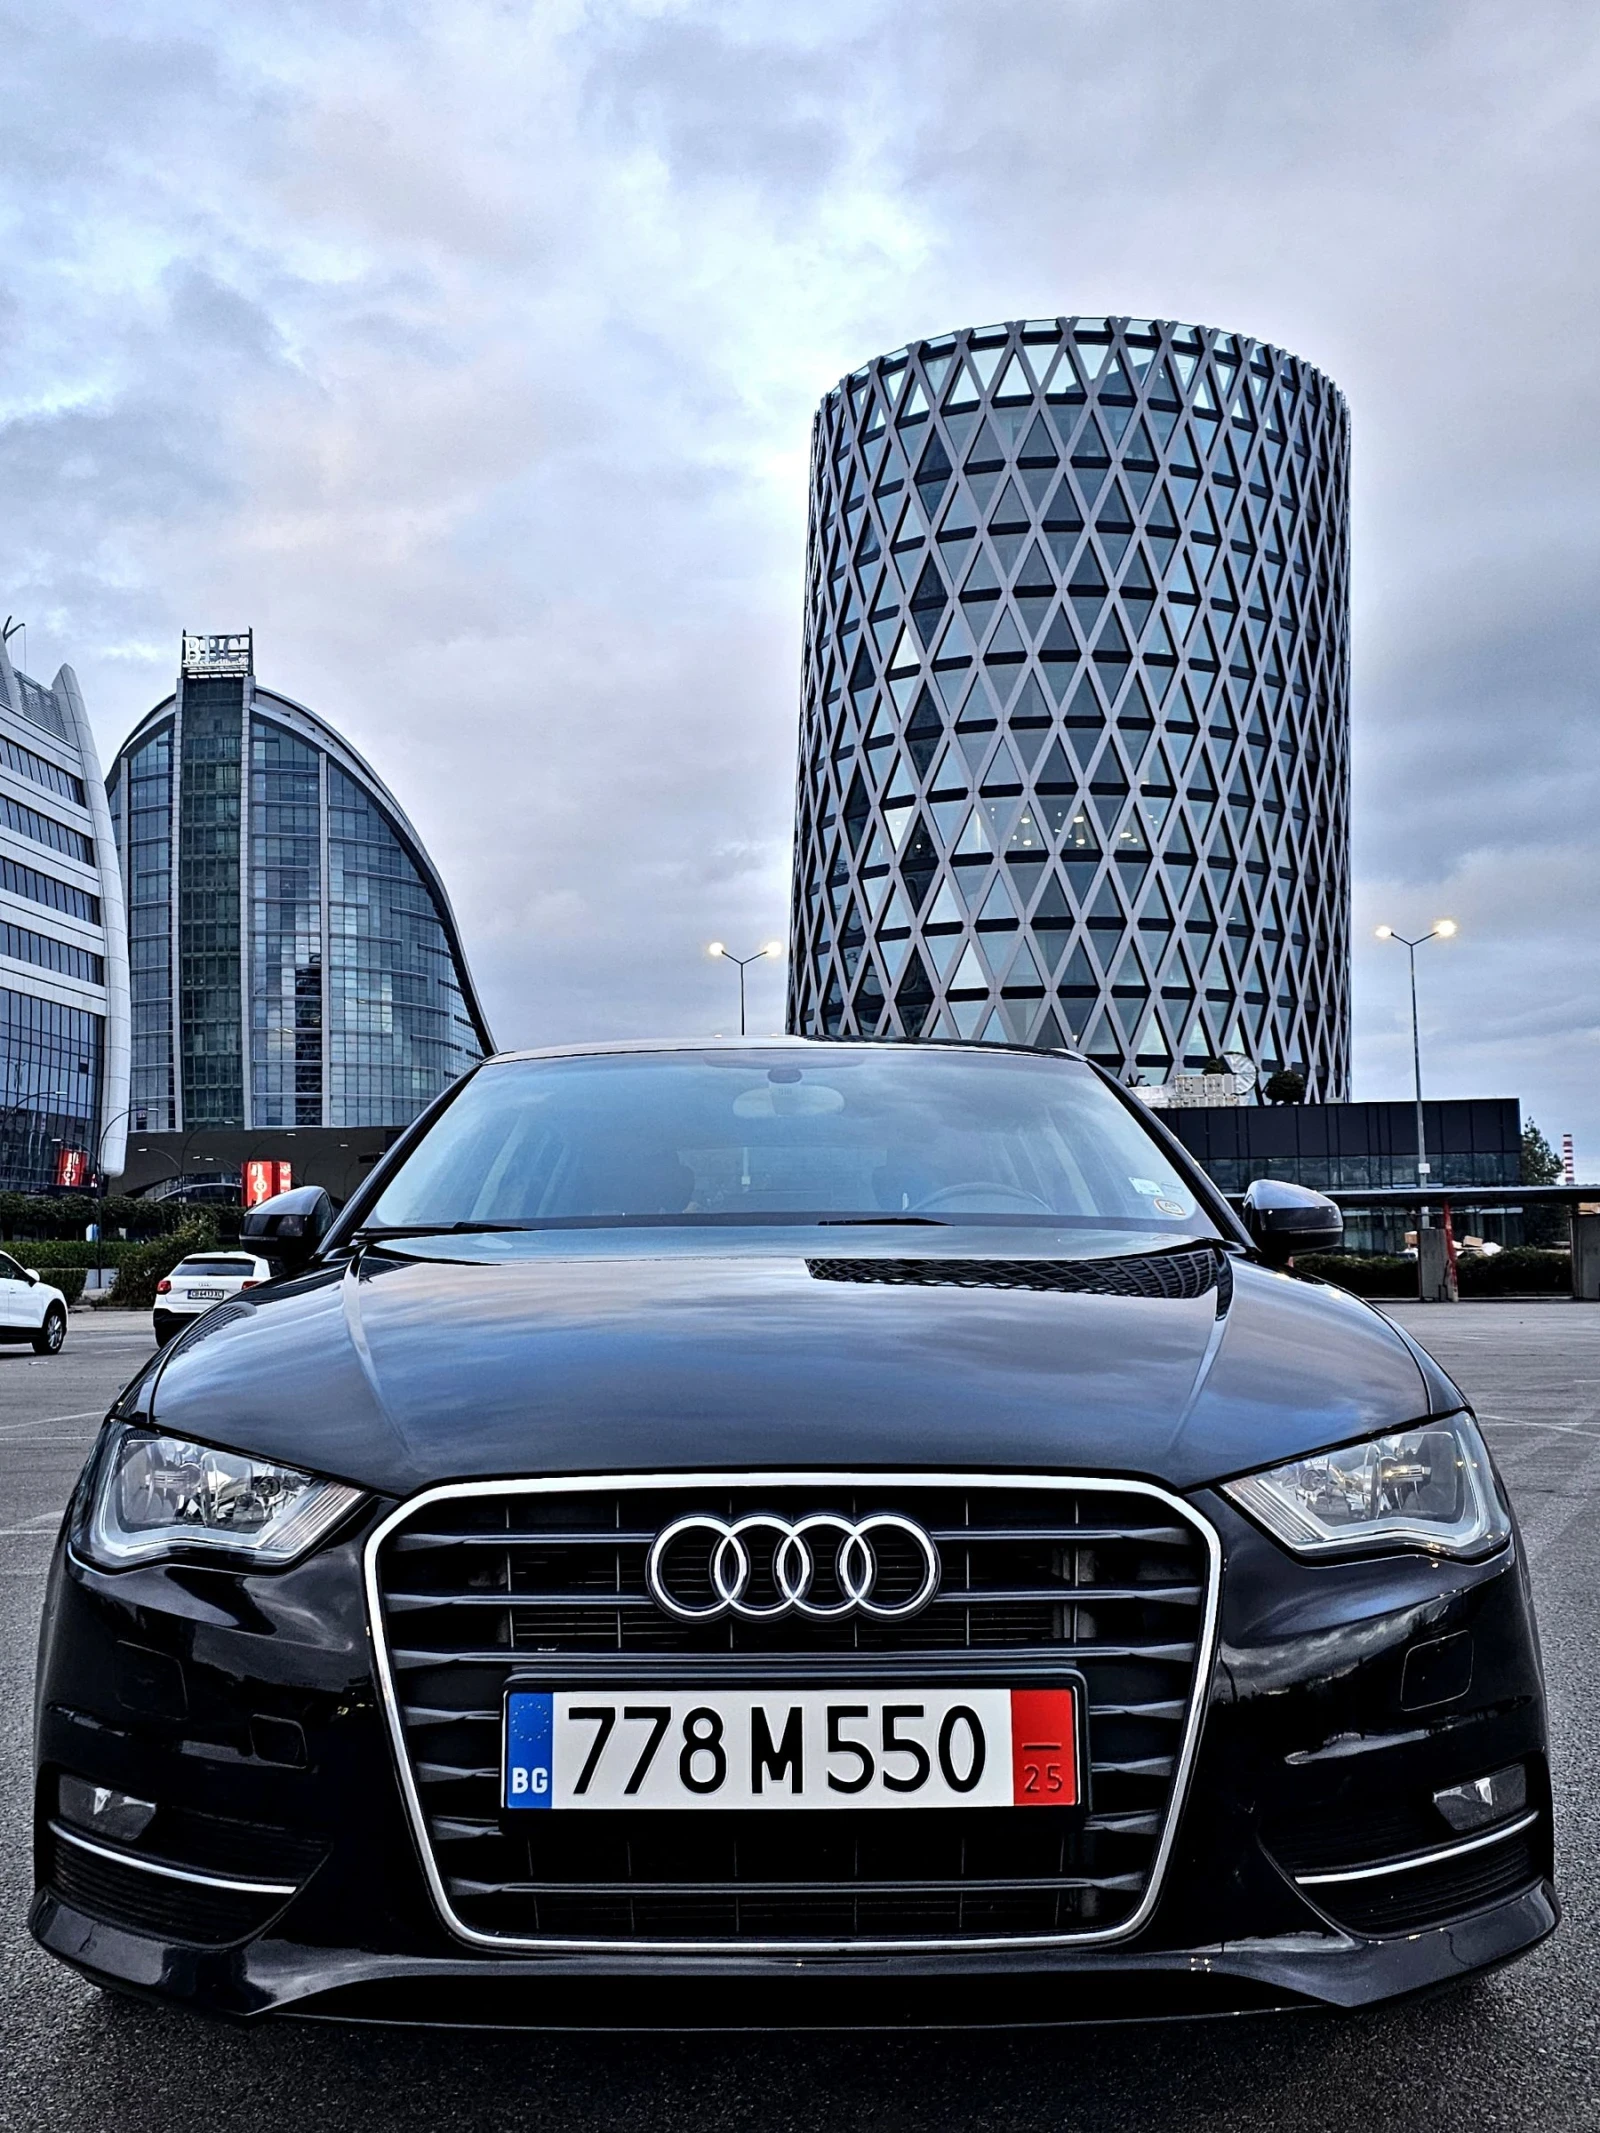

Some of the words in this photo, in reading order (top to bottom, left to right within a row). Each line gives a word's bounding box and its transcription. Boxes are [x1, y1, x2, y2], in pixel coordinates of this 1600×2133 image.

[183, 635, 241, 664] BBC
[568, 1706, 727, 1795] 778
[751, 1706, 804, 1795] M
[827, 1705, 986, 1794] 550
[512, 1767, 548, 1794] BG
[1024, 1763, 1063, 1792] 25
